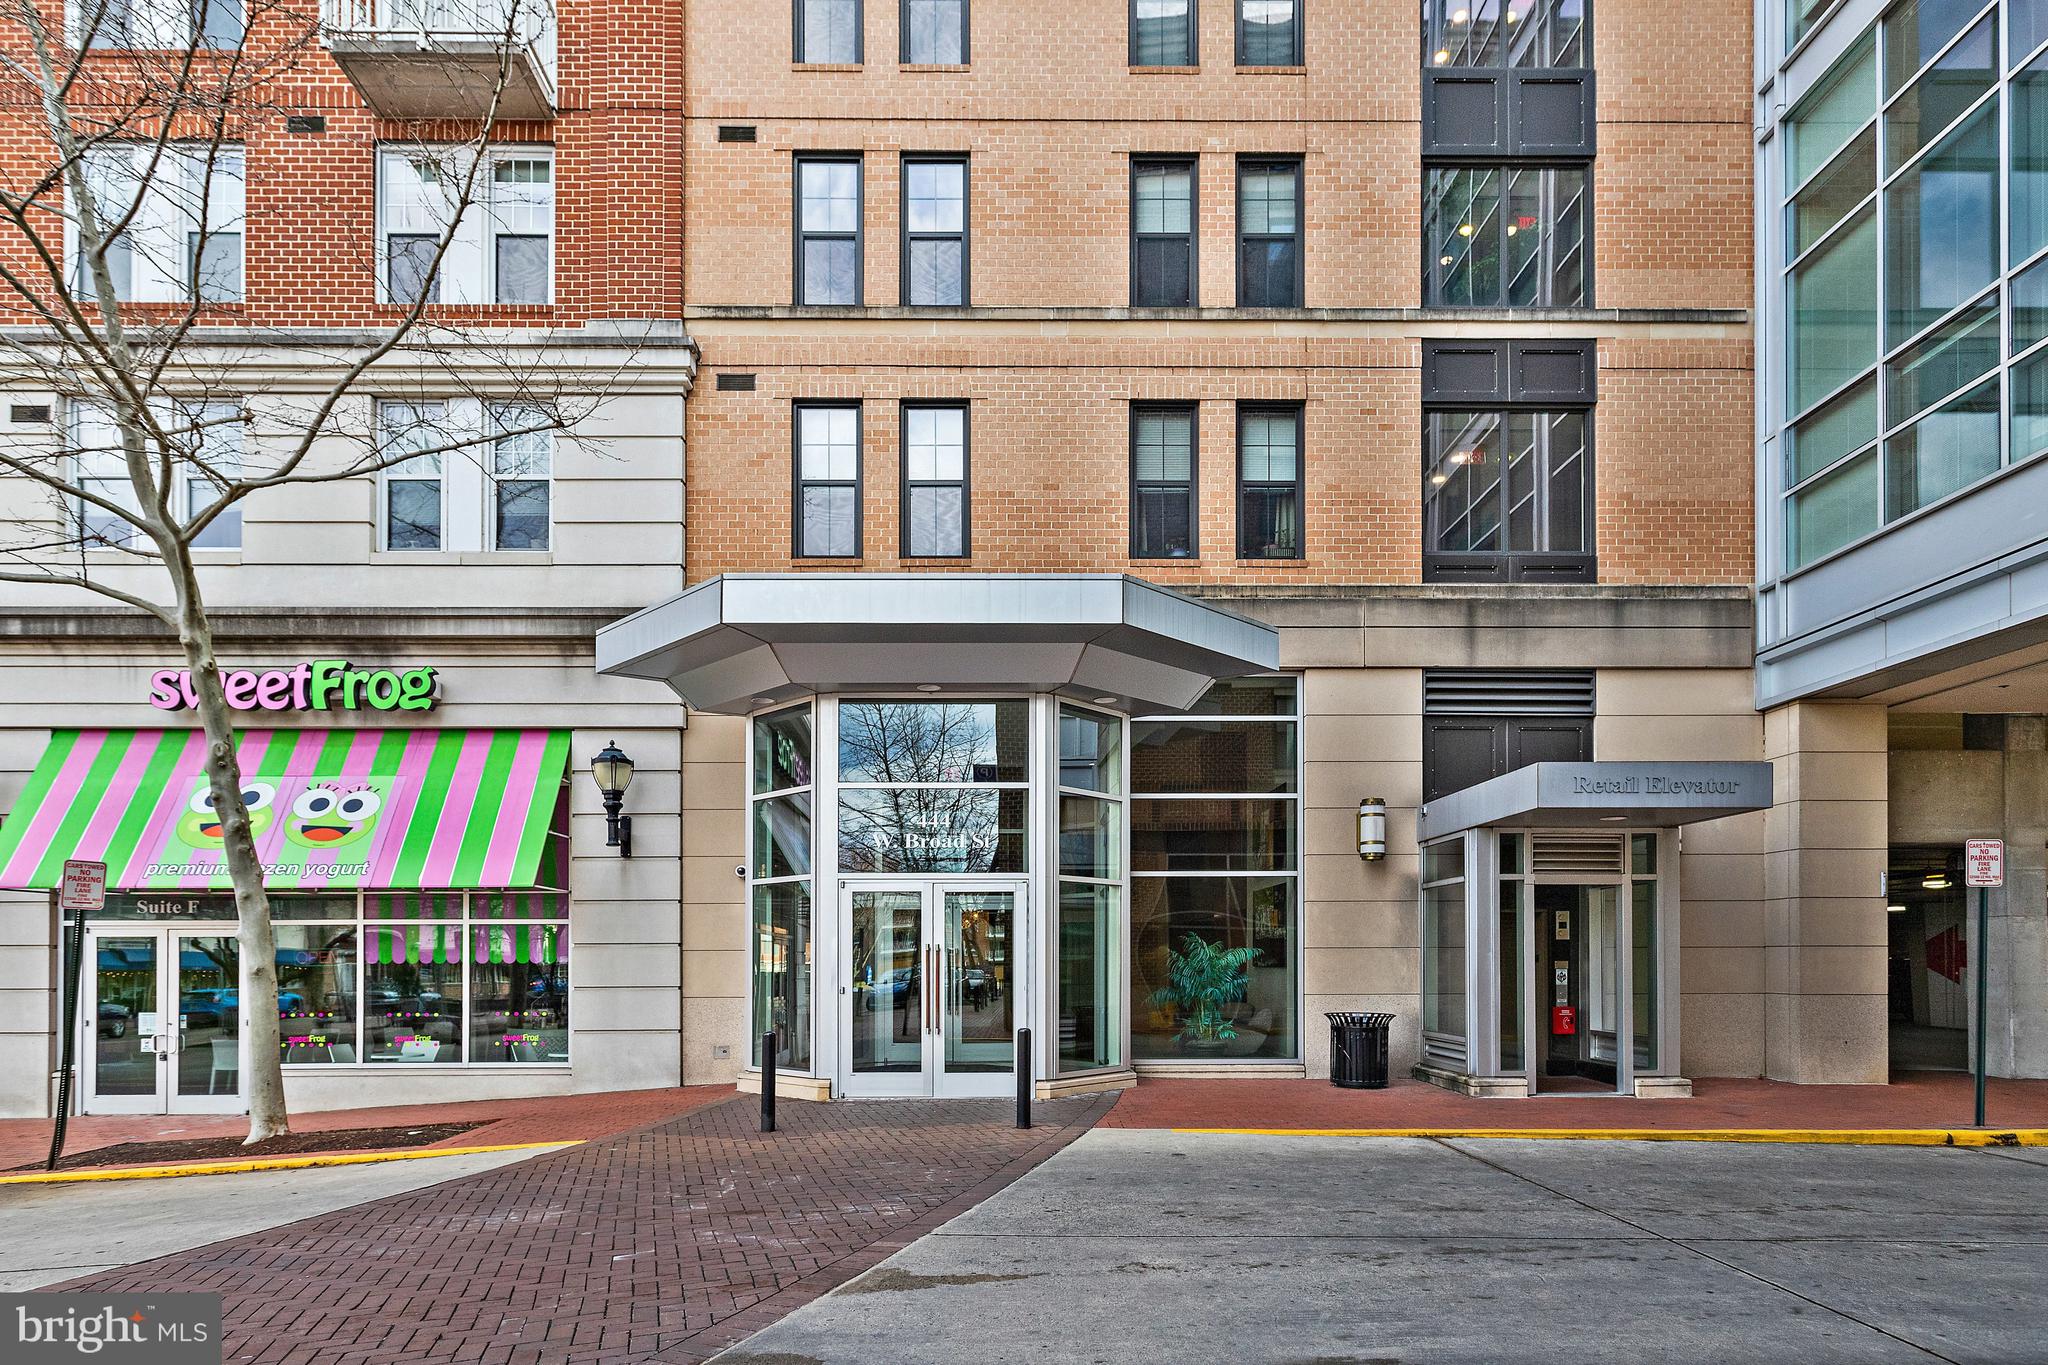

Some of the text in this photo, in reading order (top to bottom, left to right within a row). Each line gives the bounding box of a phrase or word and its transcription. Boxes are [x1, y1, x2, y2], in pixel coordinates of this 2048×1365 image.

[1573, 776, 1740, 794] Retail Elevator
[917, 812, 951, 828] 444
[873, 833, 991, 849] W. Broad St
[144, 862, 230, 878] premium
[302, 861, 370, 879] yogurt
[67, 875, 101, 883] PARKING
[136, 900, 200, 914] Suite F
